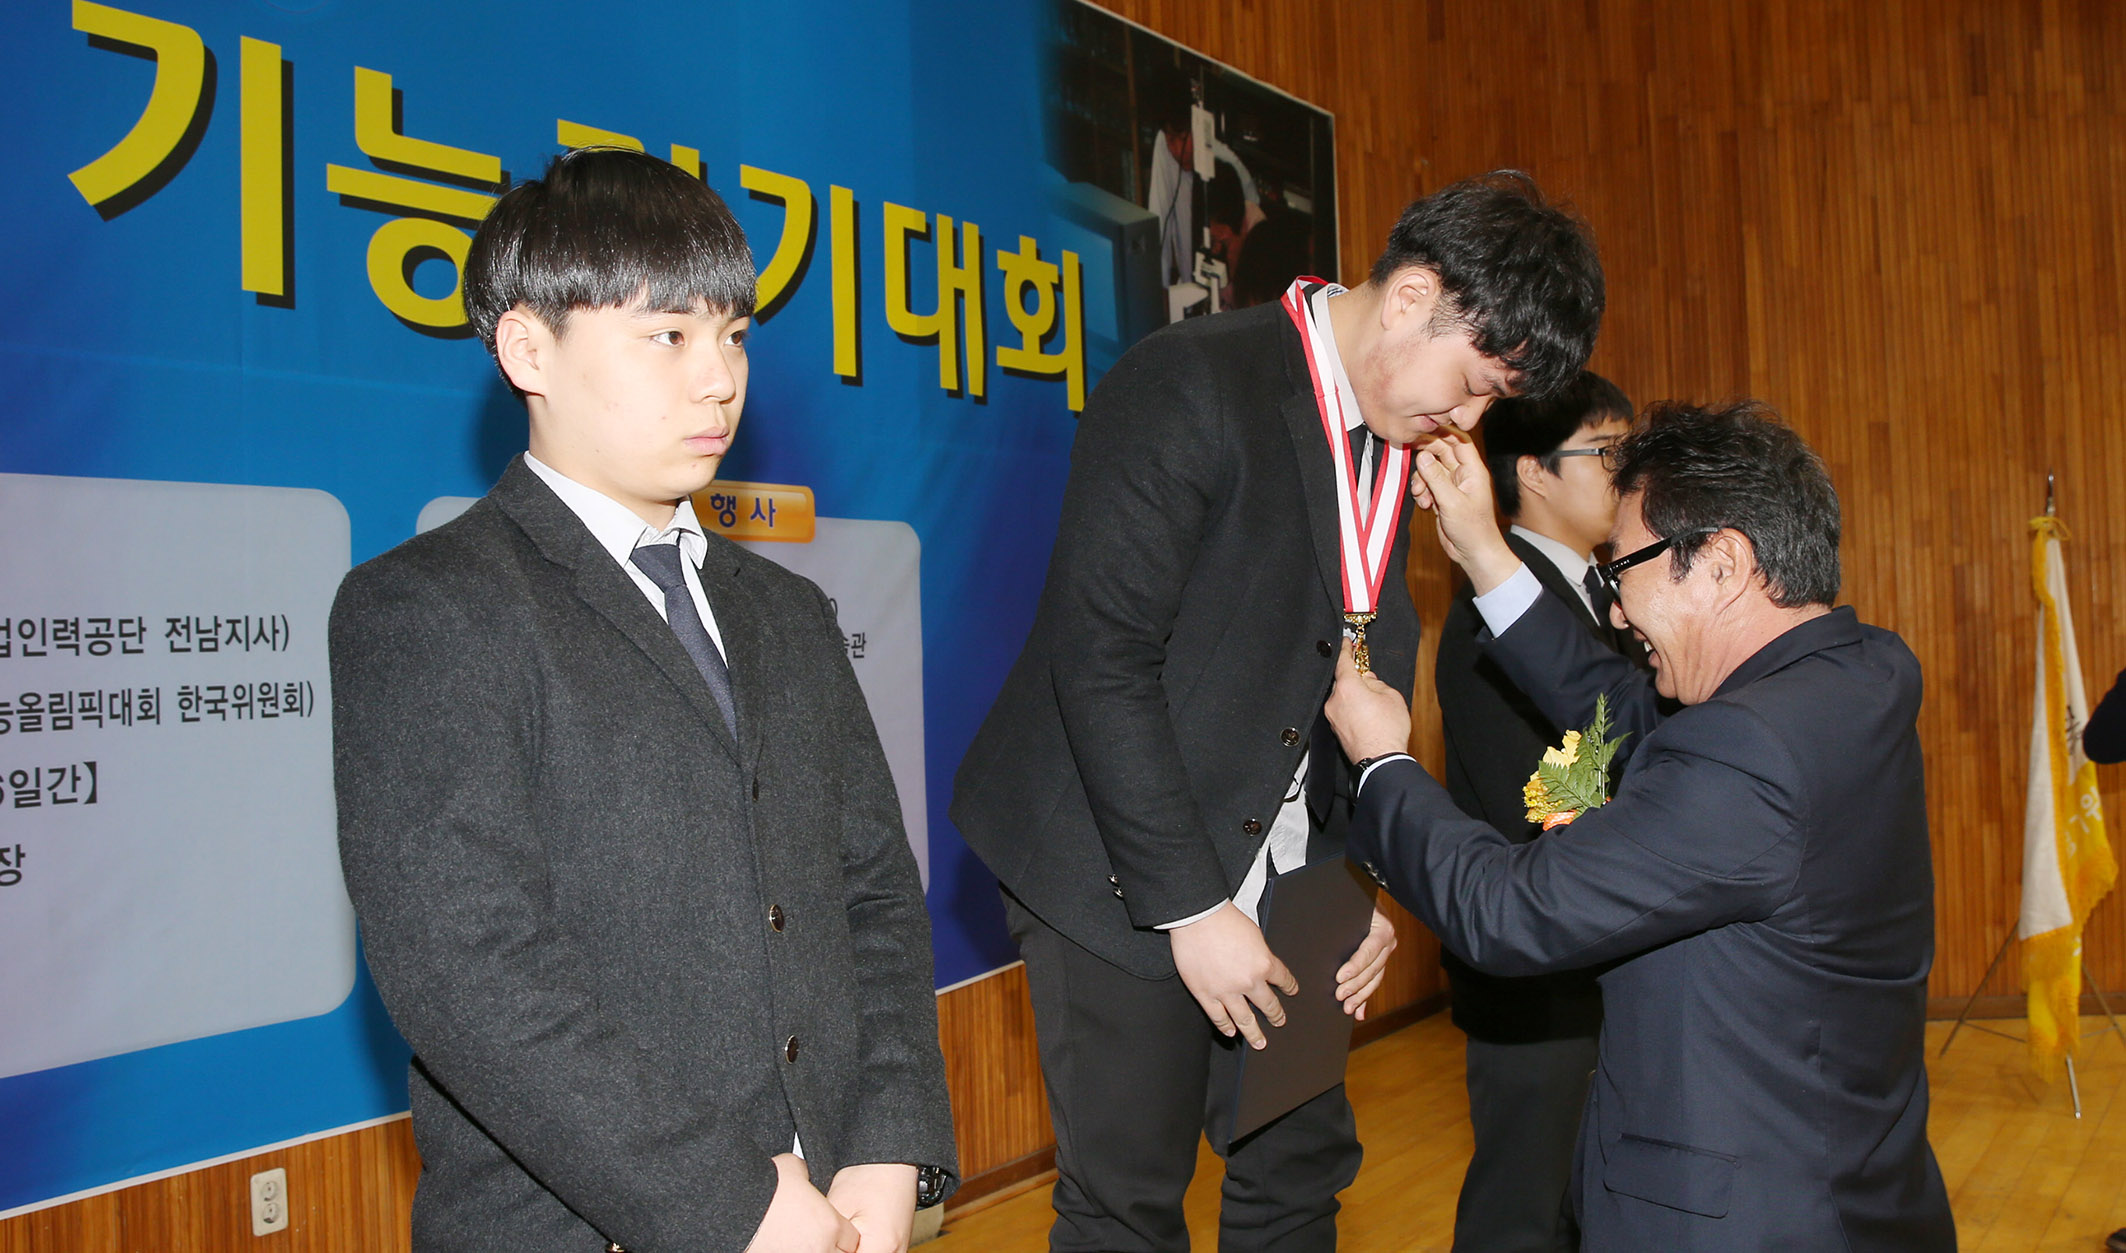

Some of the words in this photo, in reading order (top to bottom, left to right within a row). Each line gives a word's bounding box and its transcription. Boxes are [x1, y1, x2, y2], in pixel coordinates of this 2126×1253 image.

[68, 0, 1084, 413] 기능기대회
[165, 614, 290, 653] 전남지사)
[177, 681, 314, 723] 한국위원회)
[0, 761, 98, 809] 일간】
